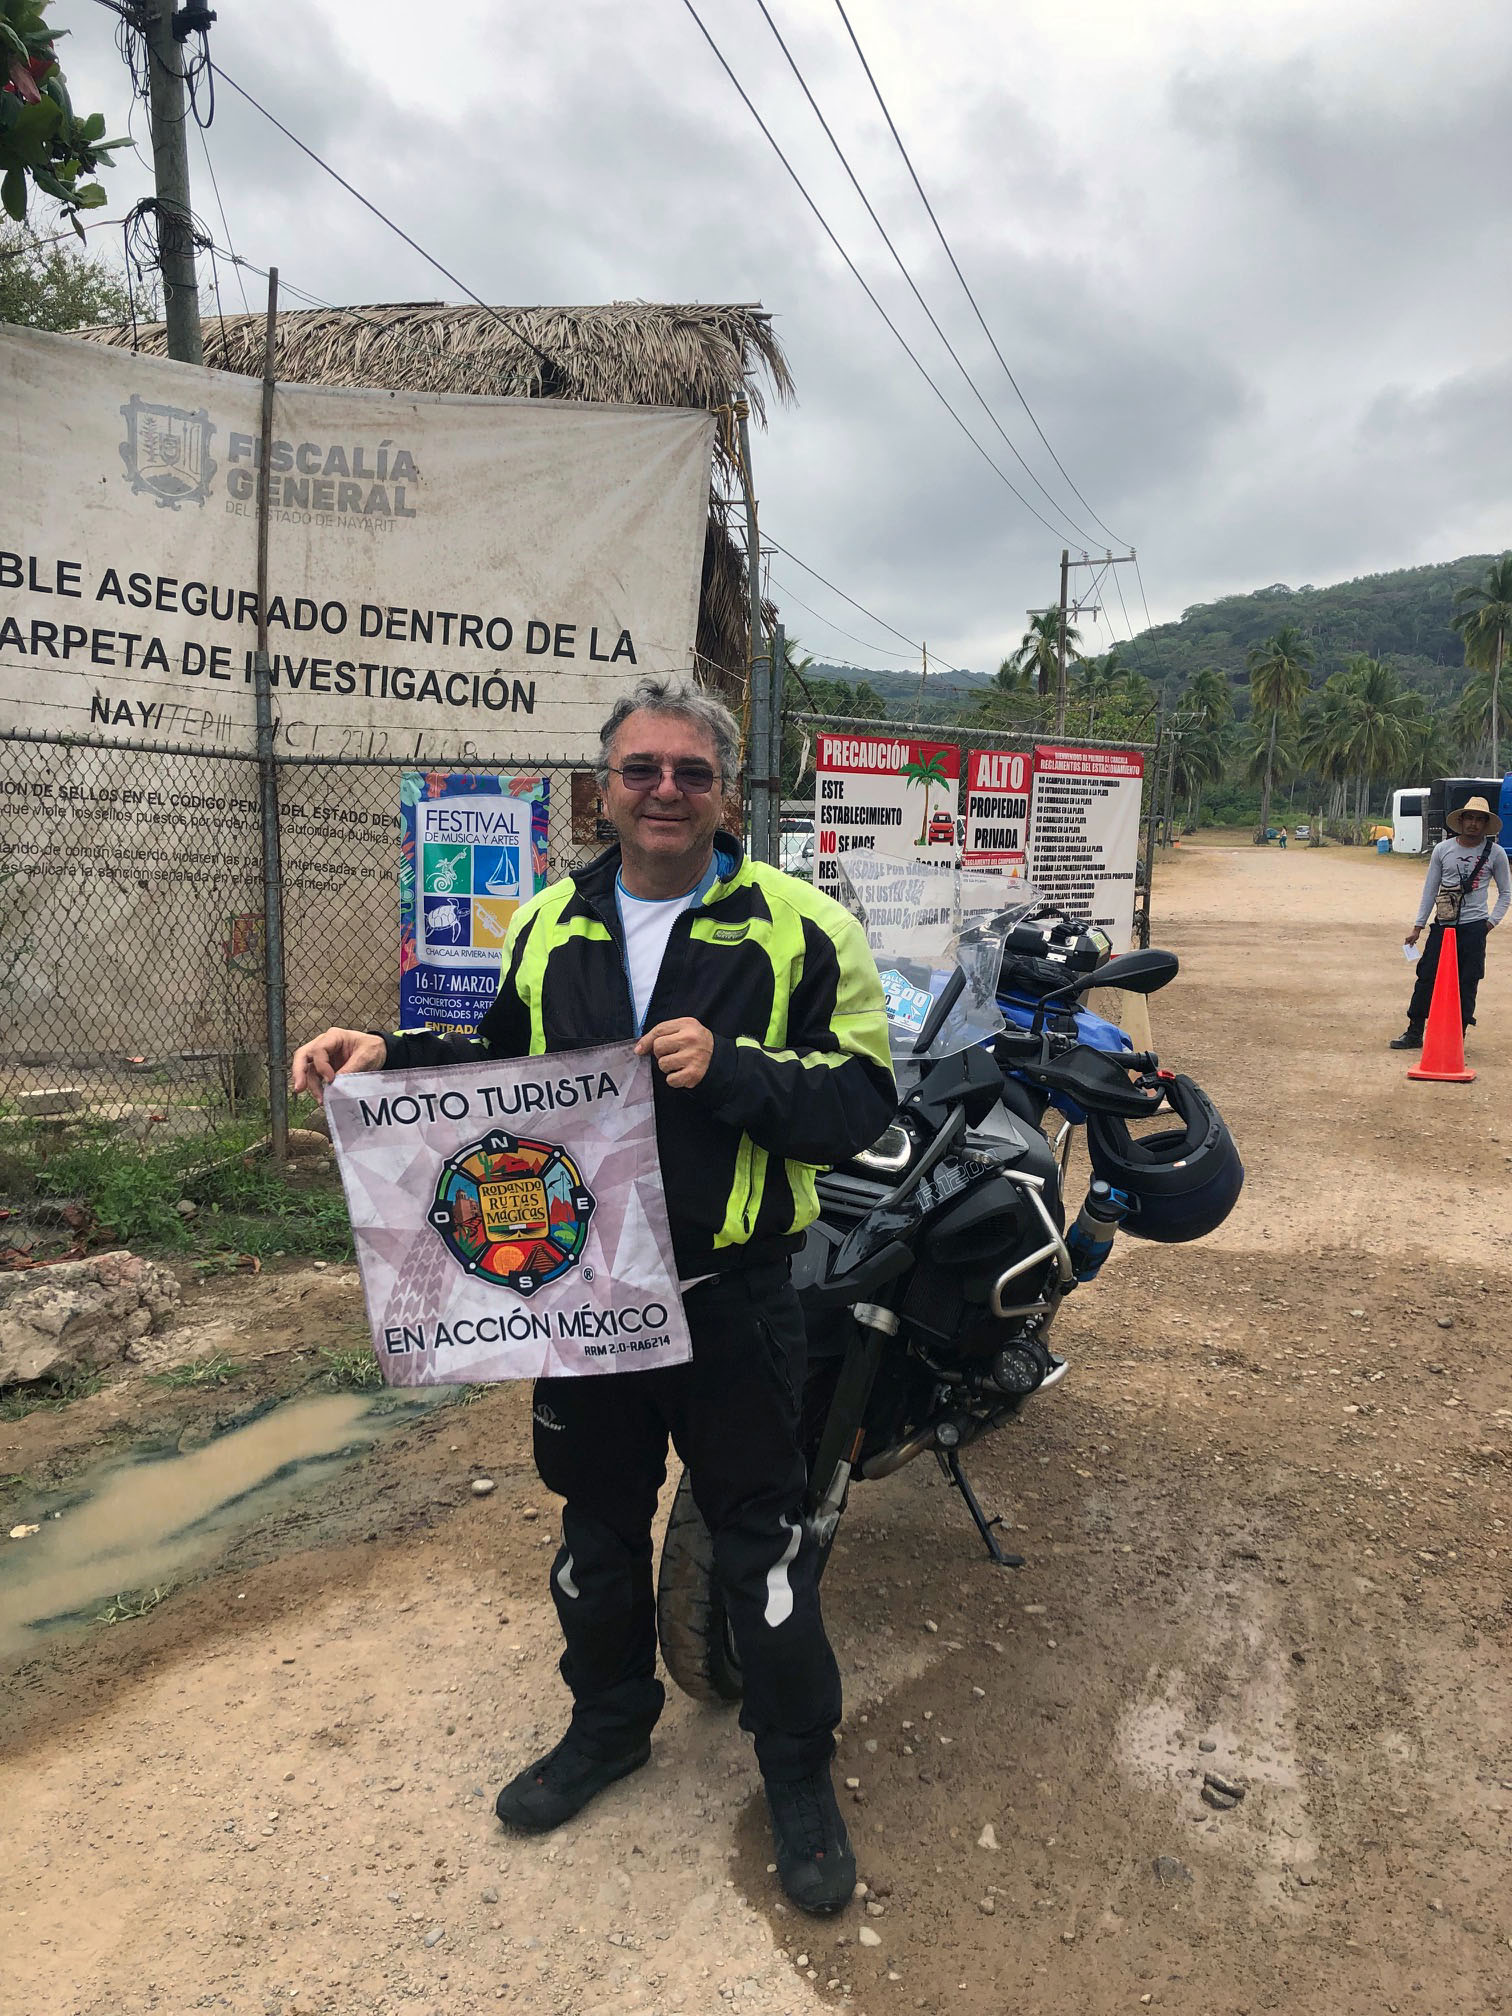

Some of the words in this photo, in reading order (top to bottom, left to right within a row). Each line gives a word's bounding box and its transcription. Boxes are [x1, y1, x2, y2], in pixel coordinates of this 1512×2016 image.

[228, 432, 418, 482] FISCALÍA
[227, 468, 416, 518] GENERAL
[226, 501, 250, 517] DEL
[316, 514, 333, 526] DE
[337, 515, 397, 532] NAYARIT
[96, 568, 347, 634] ASEGURADO
[360, 604, 512, 651] DENTRO
[526, 621, 576, 658] DE
[589, 627, 637, 665] LA
[182, 641, 231, 681] DE
[245, 651, 535, 714] INVESTIGACIÓN
[823, 738, 909, 770] PRECAUCIÓN
[977, 754, 1024, 789] ALTO
[1040, 760, 1081, 772] REGLAMENTOS
[1082, 762, 1092, 772] DEL
[1092, 763, 1140, 775] ESTACIONAMIENTO
[821, 780, 844, 800] ESTE
[1038, 786, 1044, 794] NO
[33, 784, 53, 797] DE
[59, 786, 117, 801] SELLOS
[122, 792, 142, 804] EN
[148, 792, 165, 805] EL
[170, 792, 226, 809] CÓDIGO
[231, 799, 263, 814] PEN
[281, 804, 308, 818] DEL
[313, 806, 368, 823] ESTADO
[372, 813, 389, 827] DE
[821, 805, 902, 827] ESTABLECIMIENTO
[969, 797, 1026, 819] PROPIEDAD
[426, 810, 519, 834] FESTIVAL
[94, 807, 132, 822] sellos
[287, 822, 344, 839] autoridad
[560, 856, 583, 869] tres
[425, 832, 438, 842] DE
[441, 833, 480, 843] MUSICA
[483, 835, 488, 844] Y
[491, 835, 519, 845] ARTES
[820, 830, 837, 854] NO
[838, 836, 850, 853] SE
[851, 836, 875, 851] HACE
[974, 828, 1018, 849] PRIVADA
[115, 847, 167, 861] acuerdo
[287, 858, 357, 876] interesadas
[361, 866, 376, 877] en
[426, 948, 459, 957] CHACALA
[461, 950, 486, 958] RIVIERA
[408, 996, 462, 1008] CONCIERTOS
[417, 1007, 471, 1019] ACTIVIDADES
[359, 1091, 469, 1126] MOTO
[477, 1072, 620, 1117] TURISTA
[491, 1136, 509, 1149] N
[576, 1198, 589, 1210] E
[519, 1275, 533, 1288] S
[384, 1324, 424, 1354] EN
[435, 1306, 551, 1349] ACCIÓN
[558, 1302, 668, 1339] MÉXICO
[584, 1345, 607, 1356] RRM
